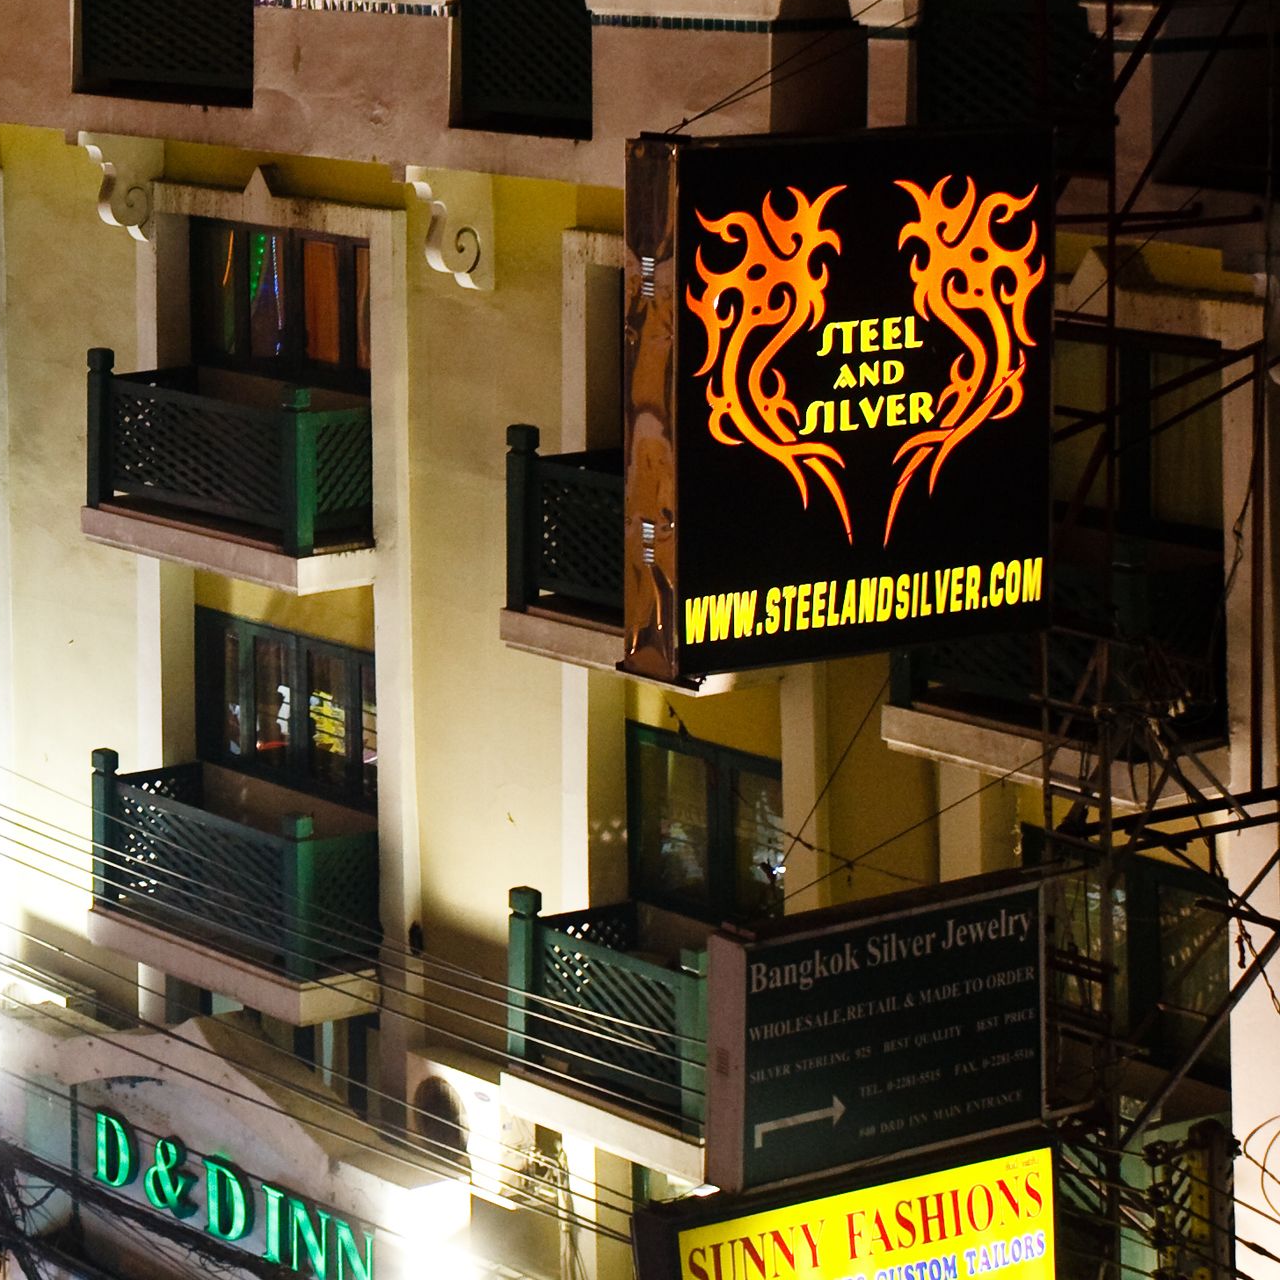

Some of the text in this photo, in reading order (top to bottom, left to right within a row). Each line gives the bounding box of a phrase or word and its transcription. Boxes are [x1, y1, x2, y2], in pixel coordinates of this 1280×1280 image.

[816, 315, 924, 357] STEEL
[832, 359, 905, 391] AND
[798, 390, 939, 436] SILVER
[684, 556, 1044, 646] WWW.STEELANDSILVER.COM
[749, 908, 1030, 993] Bangkok Silver Jewelry
[903, 993, 915, 1008] &
[919, 983, 960, 1005] MADE
[965, 977, 983, 995] TO
[986, 966, 1035, 990] ORDER
[1004, 1007, 1036, 1026] PRICE
[883, 1025, 962, 1054] BEST QUALITY
[749, 1046, 872, 1084] SILVER STERLING 925
[860, 1083, 883, 1098] TEL.
[933, 1104, 962, 1121] MAIN
[965, 1089, 1023, 1113] ENTRANCE
[94, 1110, 377, 1280] D&D INN
[688, 1171, 1043, 1280] SUNNY FASHIONS
[965, 1231, 1045, 1274] TAILORS
